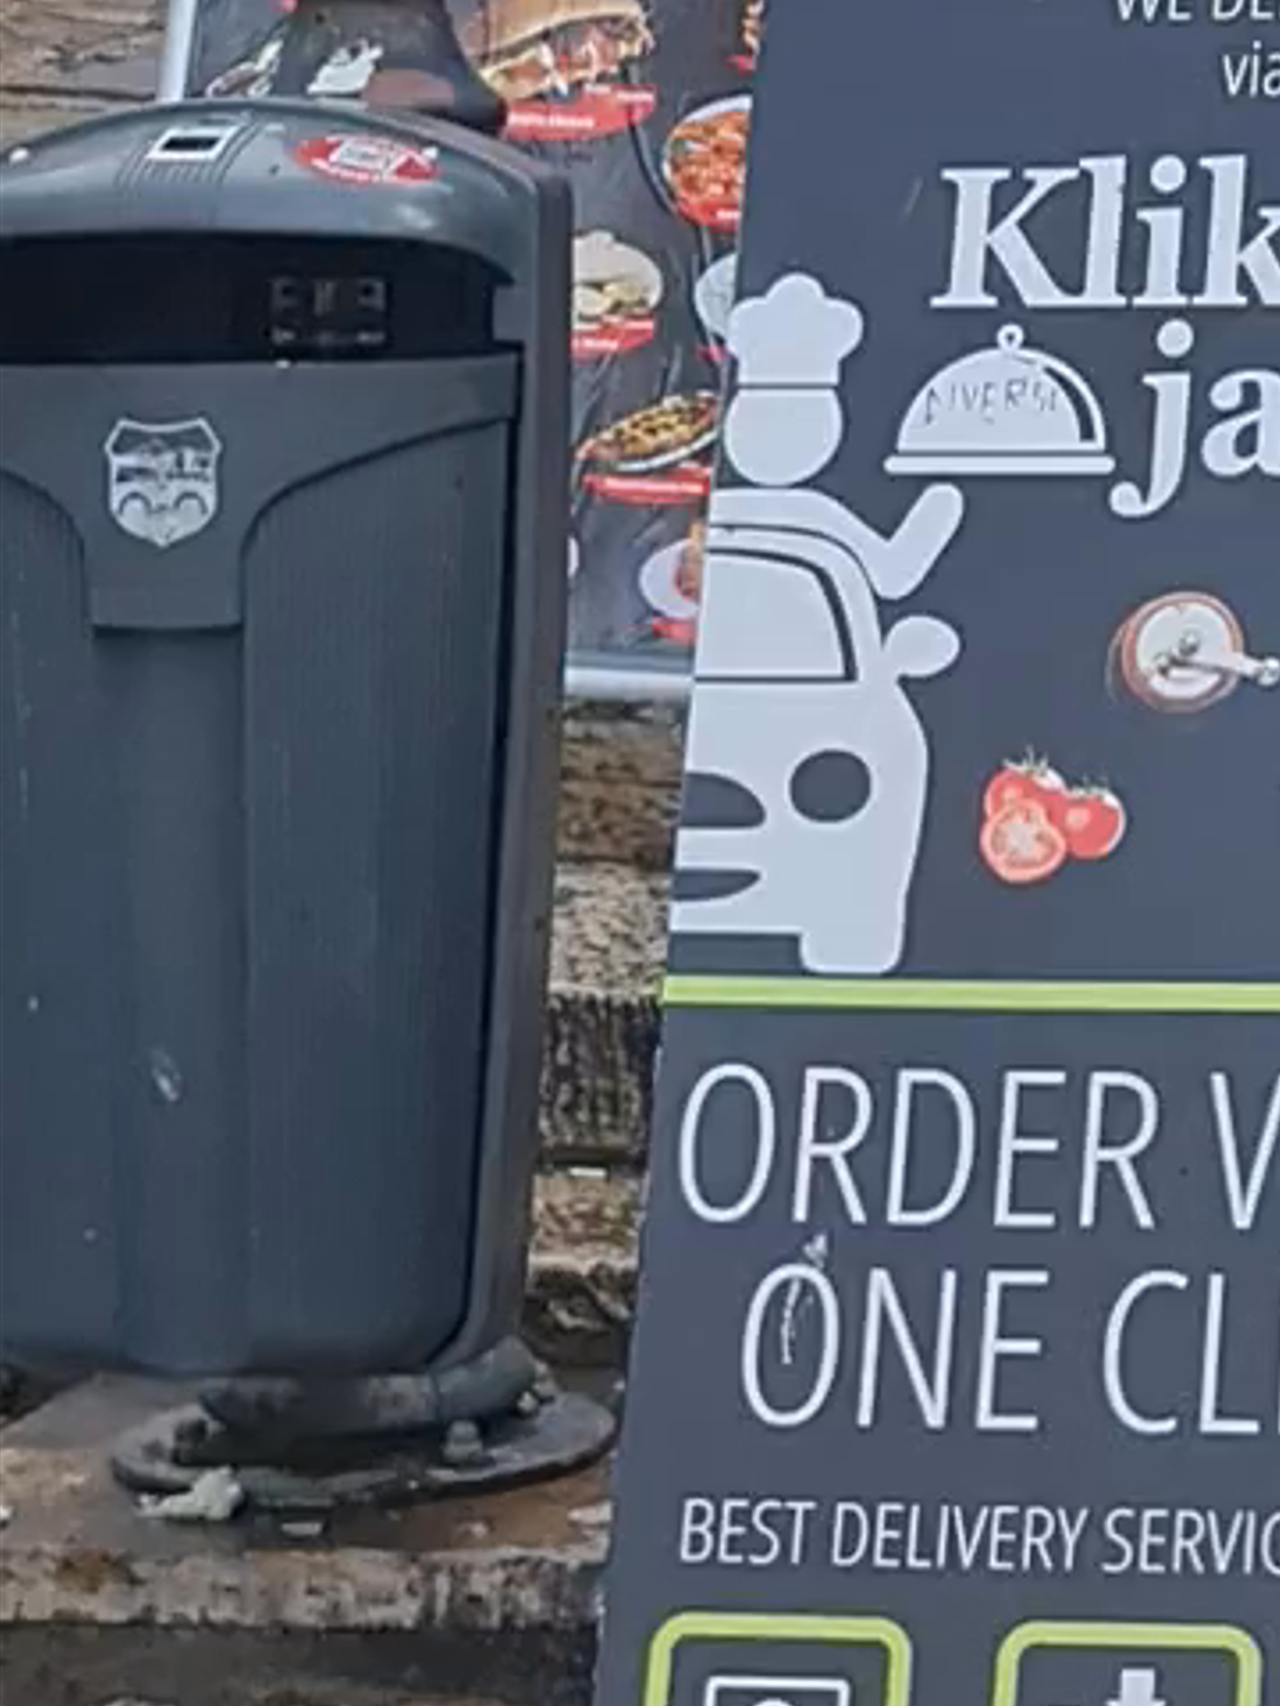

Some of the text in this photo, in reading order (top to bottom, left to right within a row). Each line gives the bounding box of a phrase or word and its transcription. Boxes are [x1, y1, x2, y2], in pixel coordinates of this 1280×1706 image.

[677, 1061, 1160, 1231] ORDER
[740, 1263, 1051, 1432] ONE
[678, 1496, 818, 1567] BEST
[830, 1500, 1089, 1572] DELIVERY
